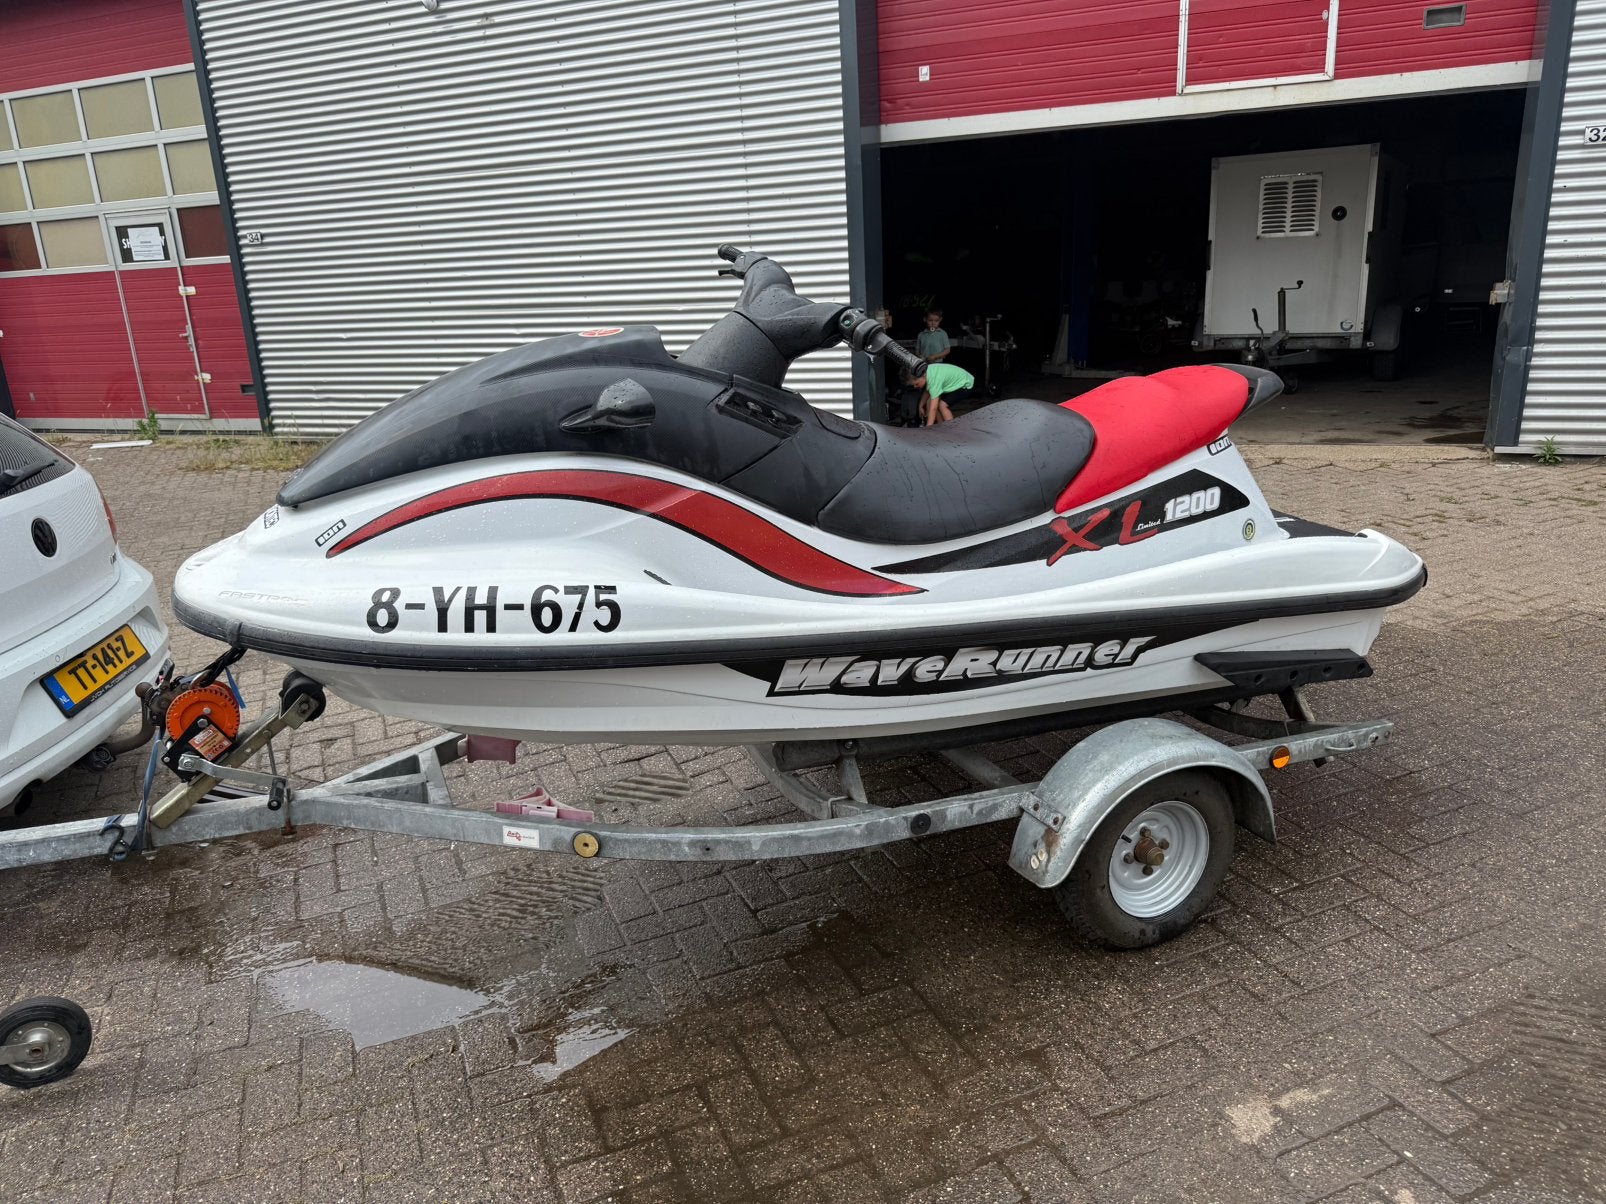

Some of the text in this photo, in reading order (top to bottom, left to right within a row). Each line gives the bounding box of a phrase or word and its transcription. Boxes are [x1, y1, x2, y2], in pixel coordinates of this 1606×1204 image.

[1046, 486, 1221, 566] XL Limited 1200
[366, 584, 622, 634] 8-YH-675
[67, 634, 135, 691] TT-141-Z
[773, 636, 1158, 692] WaveRunner
[58, 694, 71, 705] NL
